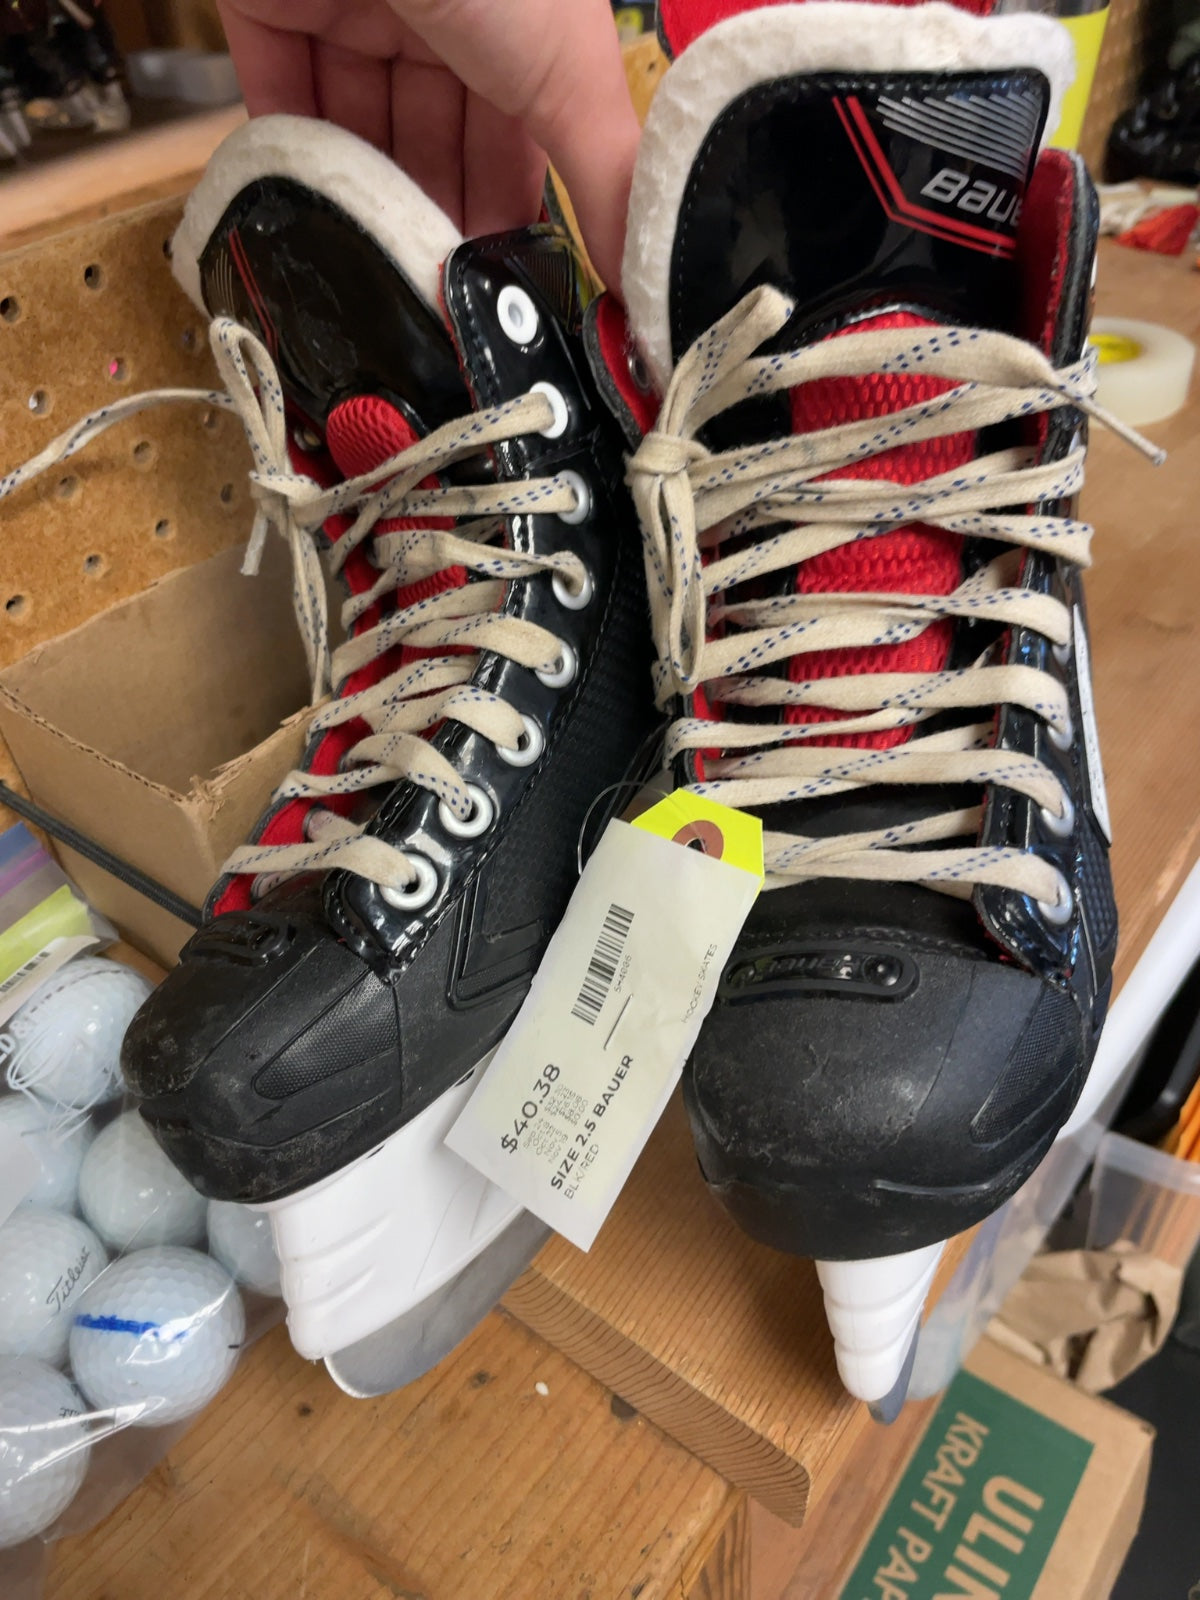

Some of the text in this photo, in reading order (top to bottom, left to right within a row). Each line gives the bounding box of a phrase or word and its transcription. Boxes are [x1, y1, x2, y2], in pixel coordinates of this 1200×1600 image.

[681, 943, 718, 1024] HOCKEY SKATES
[501, 1064, 560, 1153] $40.38
[551, 1055, 633, 1190] SIZE 2.5 BAUER
[564, 1144, 599, 1200] BLK/RED
[863, 1411, 990, 1600] KRAFT PAP
